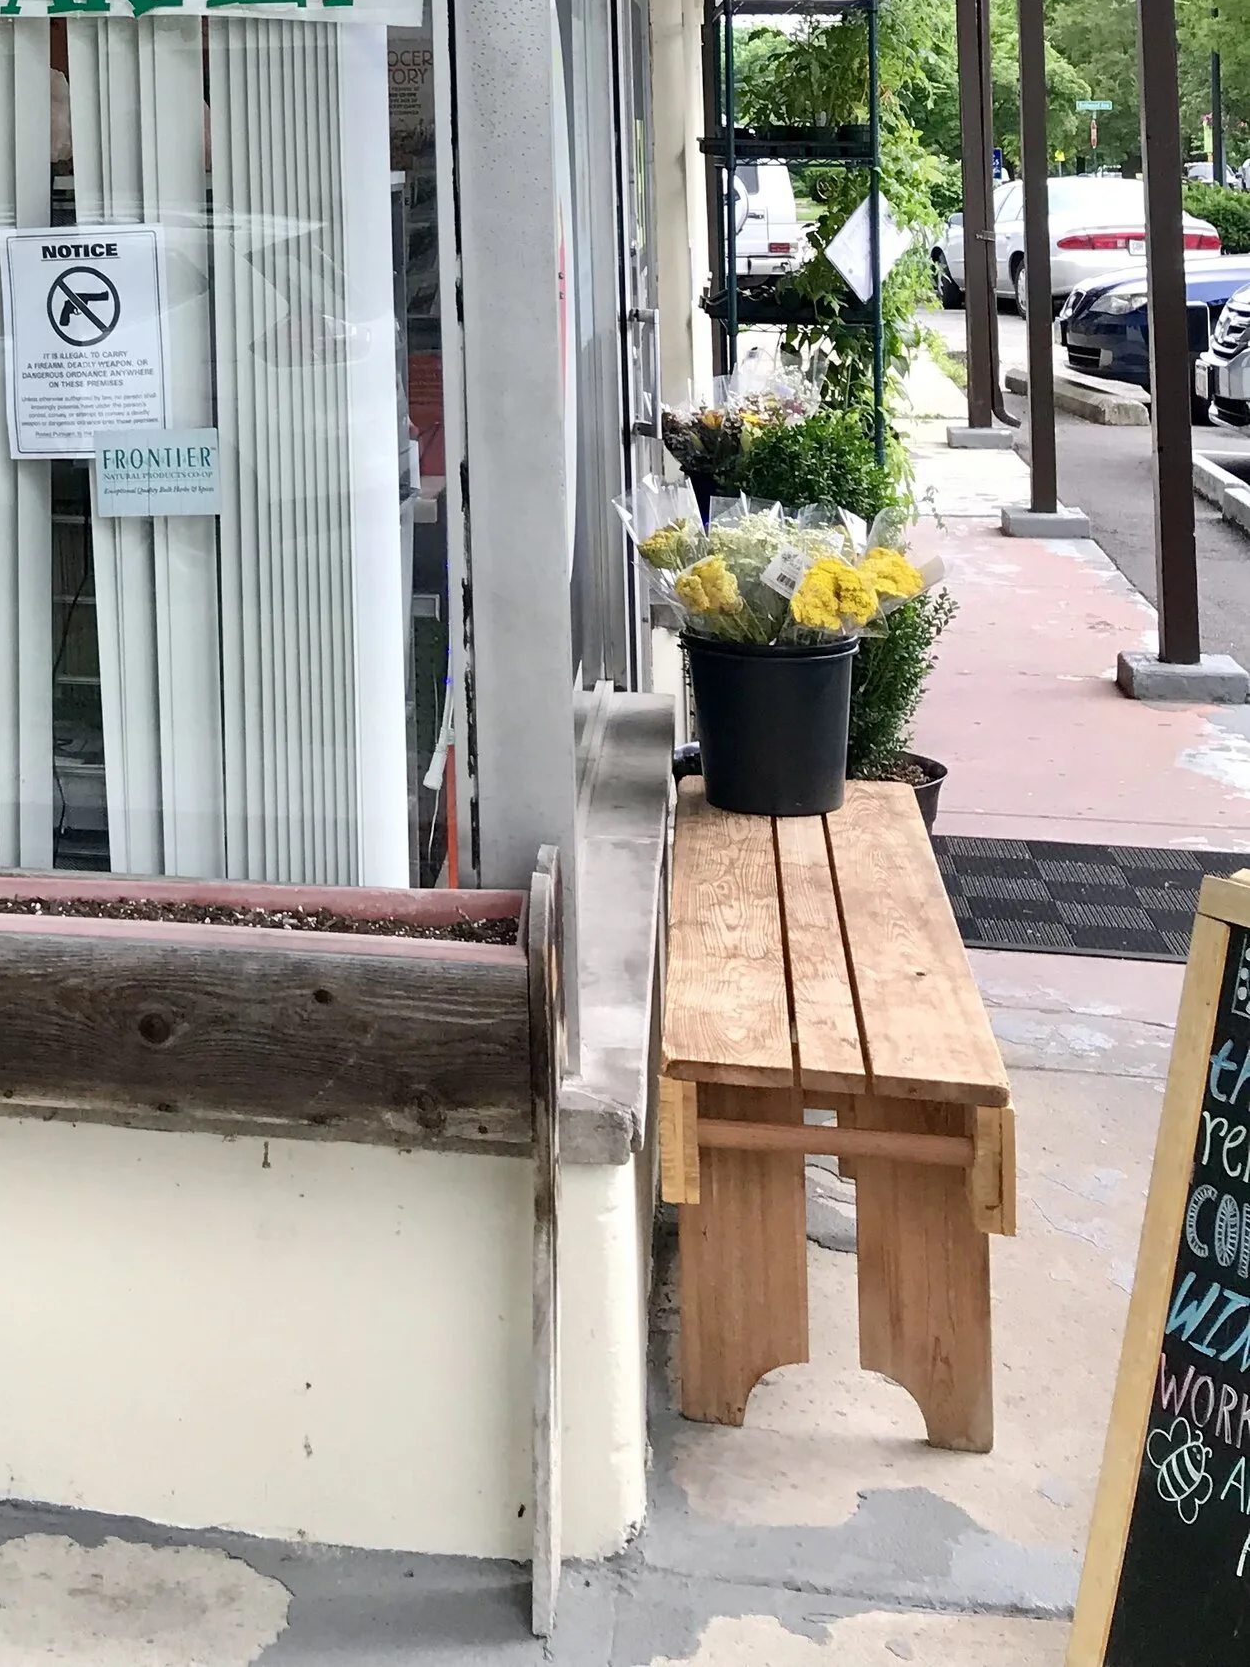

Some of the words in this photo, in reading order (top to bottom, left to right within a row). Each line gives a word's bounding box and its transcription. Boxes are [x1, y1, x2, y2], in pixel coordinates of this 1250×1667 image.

[41, 242, 119, 259] NOTICE
[43, 352, 50, 360] IT
[59, 351, 88, 360] ILLEGAL
[90, 351, 100, 359] TO
[102, 350, 128, 358] CARRY
[67, 361, 96, 369] DEADLY
[22, 371, 64, 379] DANGEROUS
[65, 370, 107, 378] ORDNANCE
[110, 368, 154, 377] ANYWHERE
[61, 380, 84, 388] THESE
[102, 446, 212, 470] FRONTIER
[142, 472, 187, 480] PRODUCTS
[1202, 1110, 1250, 1184] re
[1220, 1455, 1250, 1516] A
